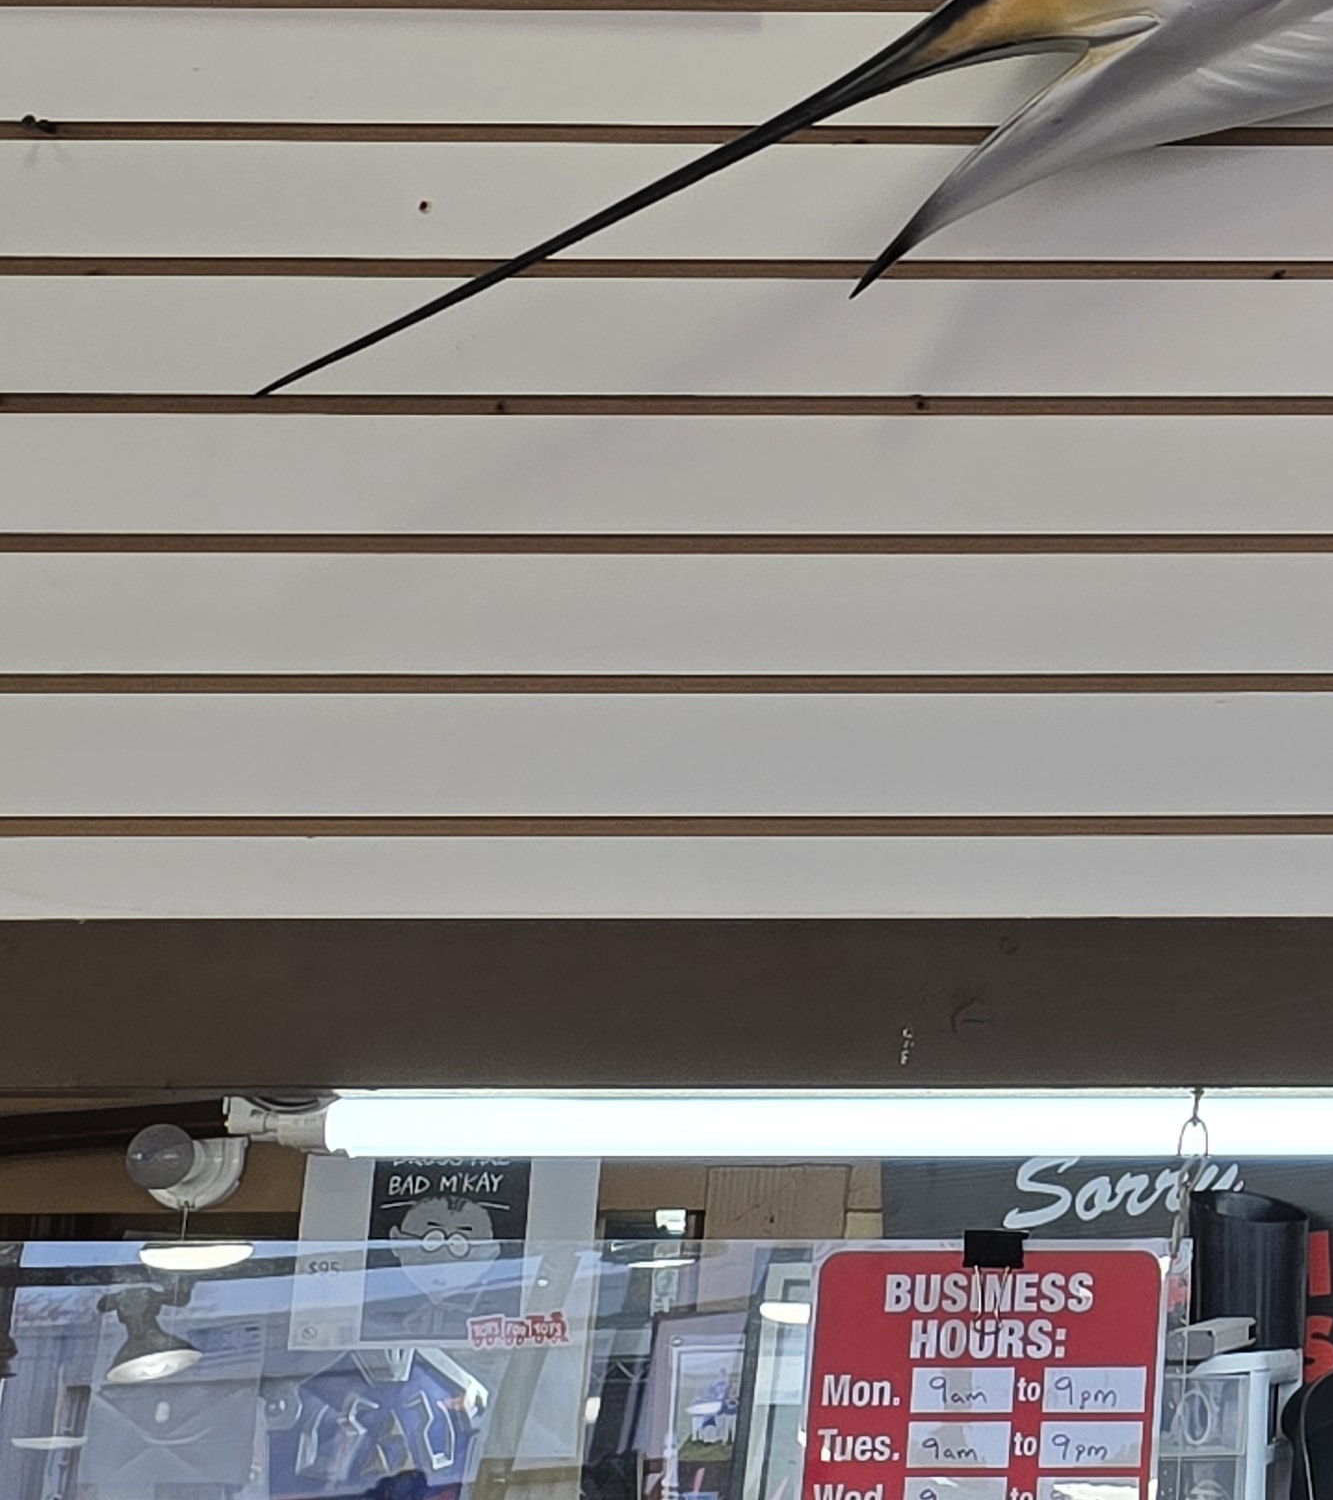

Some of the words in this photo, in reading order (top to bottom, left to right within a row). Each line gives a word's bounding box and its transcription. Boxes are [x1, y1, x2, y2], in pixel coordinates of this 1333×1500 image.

[388, 1175, 431, 1197] BAD
[438, 1171, 504, 1193] M'KAY
[884, 1272, 1095, 1314] BUSINESS
[909, 1318, 1067, 1360] HOURS:
[821, 1374, 901, 1407] Mon.
[928, 1375, 988, 1405] 9am
[1017, 1378, 1041, 1402] to
[818, 1428, 900, 1463] Tues.
[1013, 1432, 1038, 1457] to
